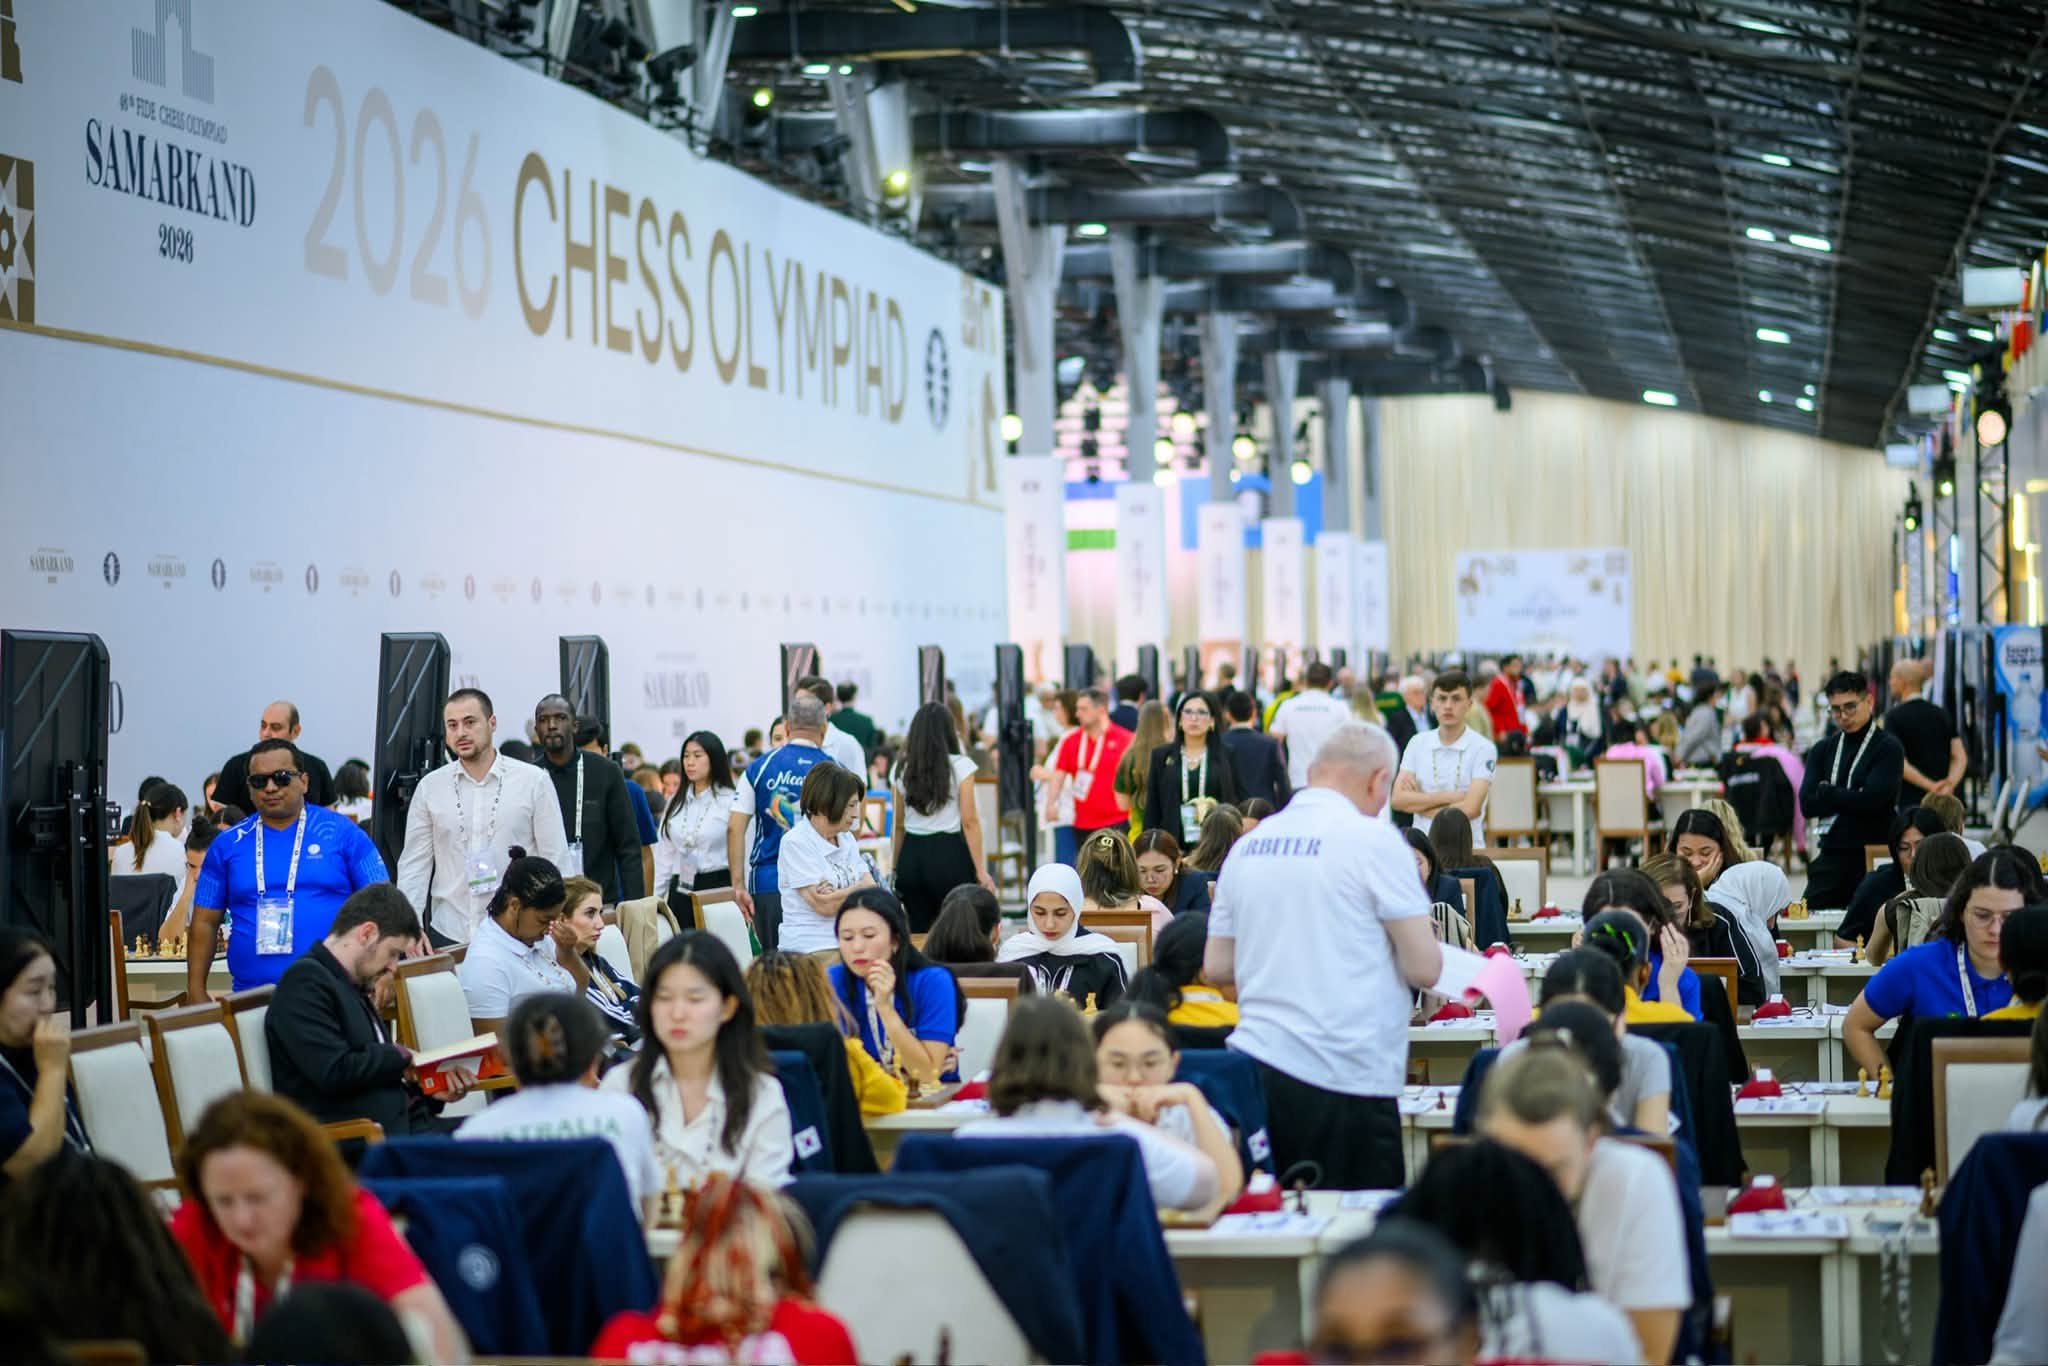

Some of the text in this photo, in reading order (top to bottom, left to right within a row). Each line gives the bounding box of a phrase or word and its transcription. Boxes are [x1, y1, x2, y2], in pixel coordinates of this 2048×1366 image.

[136, 97, 157, 121] FIDE
[158, 104, 185, 132] CHESS
[86, 117, 256, 229] SAMARKAND
[158, 222, 194, 265] 2026
[303, 65, 908, 424] 2026 CHESS OLYMPIAD
[766, 769, 807, 790] Nica
